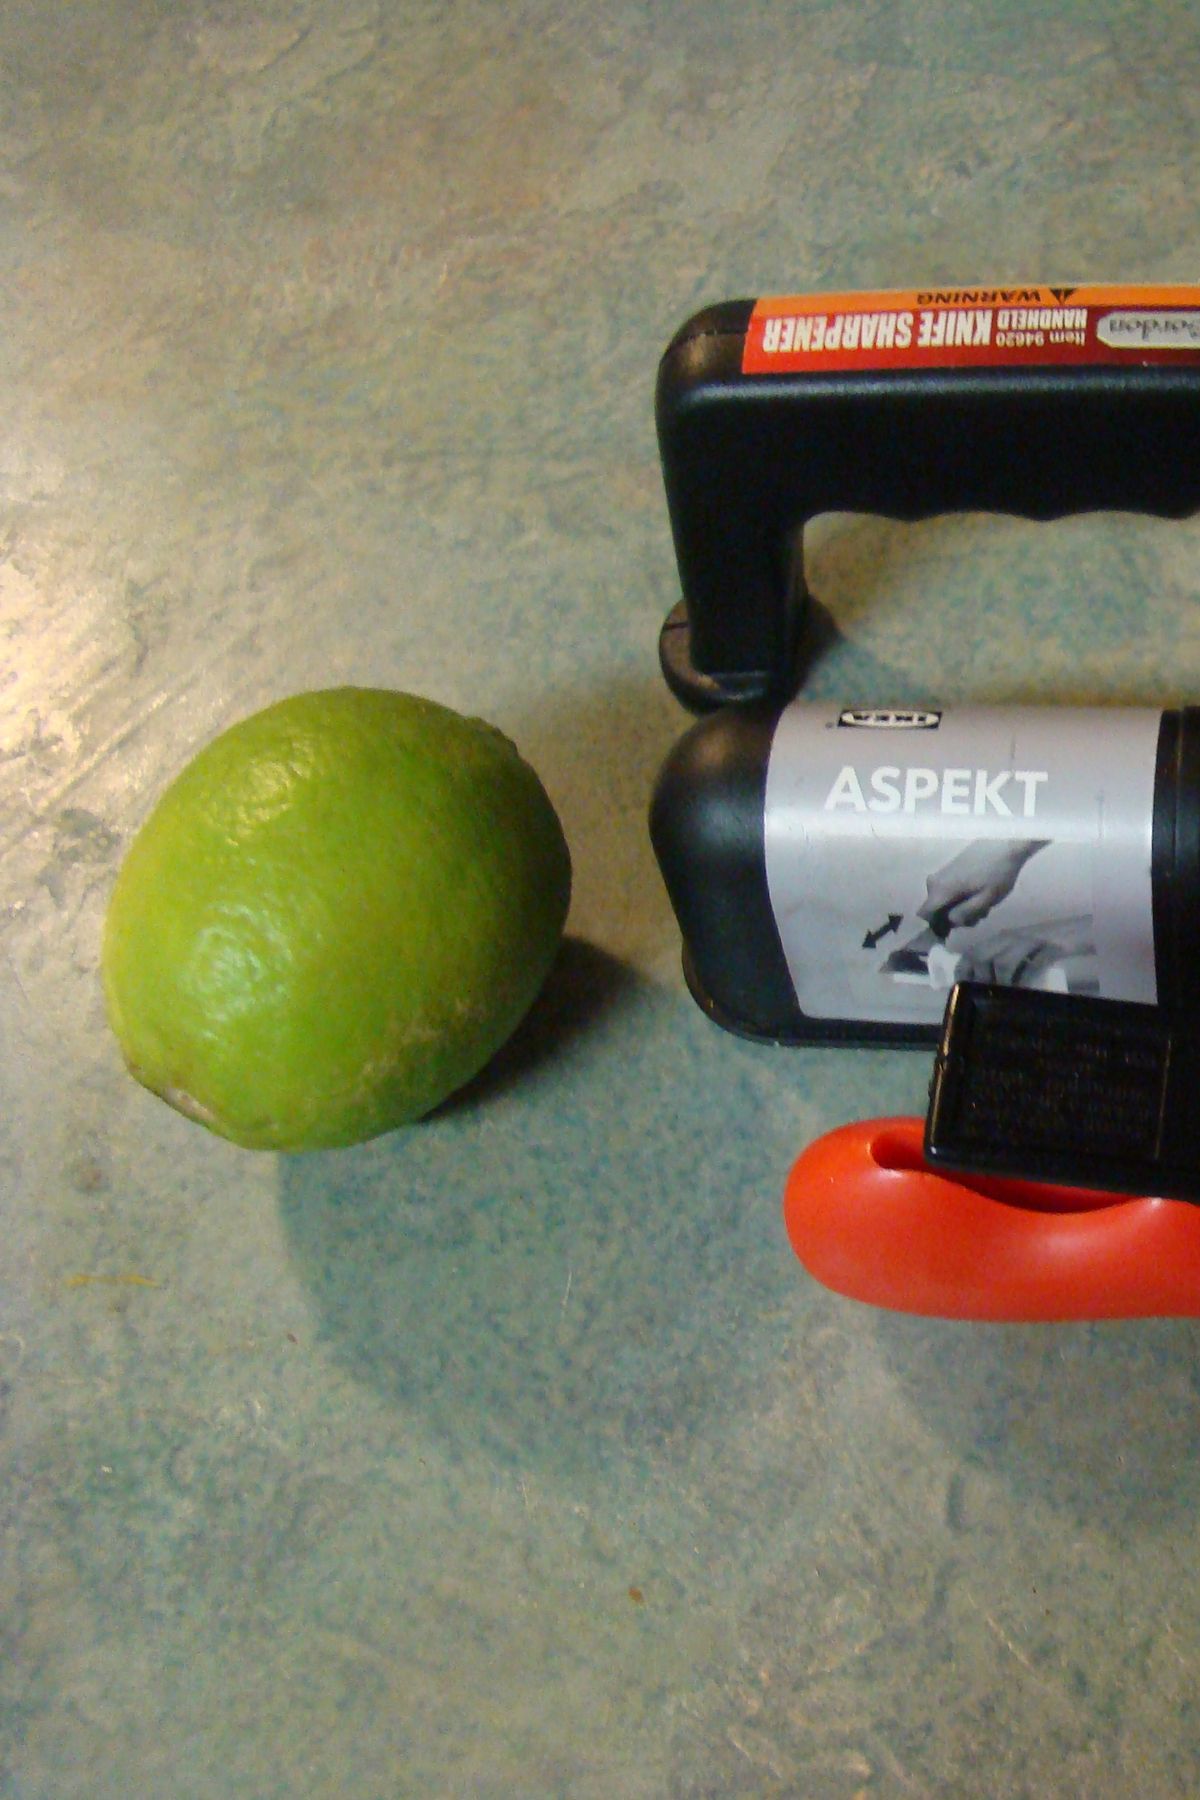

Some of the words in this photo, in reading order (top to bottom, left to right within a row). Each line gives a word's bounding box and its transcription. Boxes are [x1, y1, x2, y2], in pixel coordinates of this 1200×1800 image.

[917, 289, 1041, 305] WARNING
[763, 311, 914, 352] SHARPENER
[917, 309, 993, 347] KNIFE
[997, 308, 1088, 330] HANDHELD
[1050, 330, 1086, 346] Item
[824, 766, 1049, 817] ASPEKT
